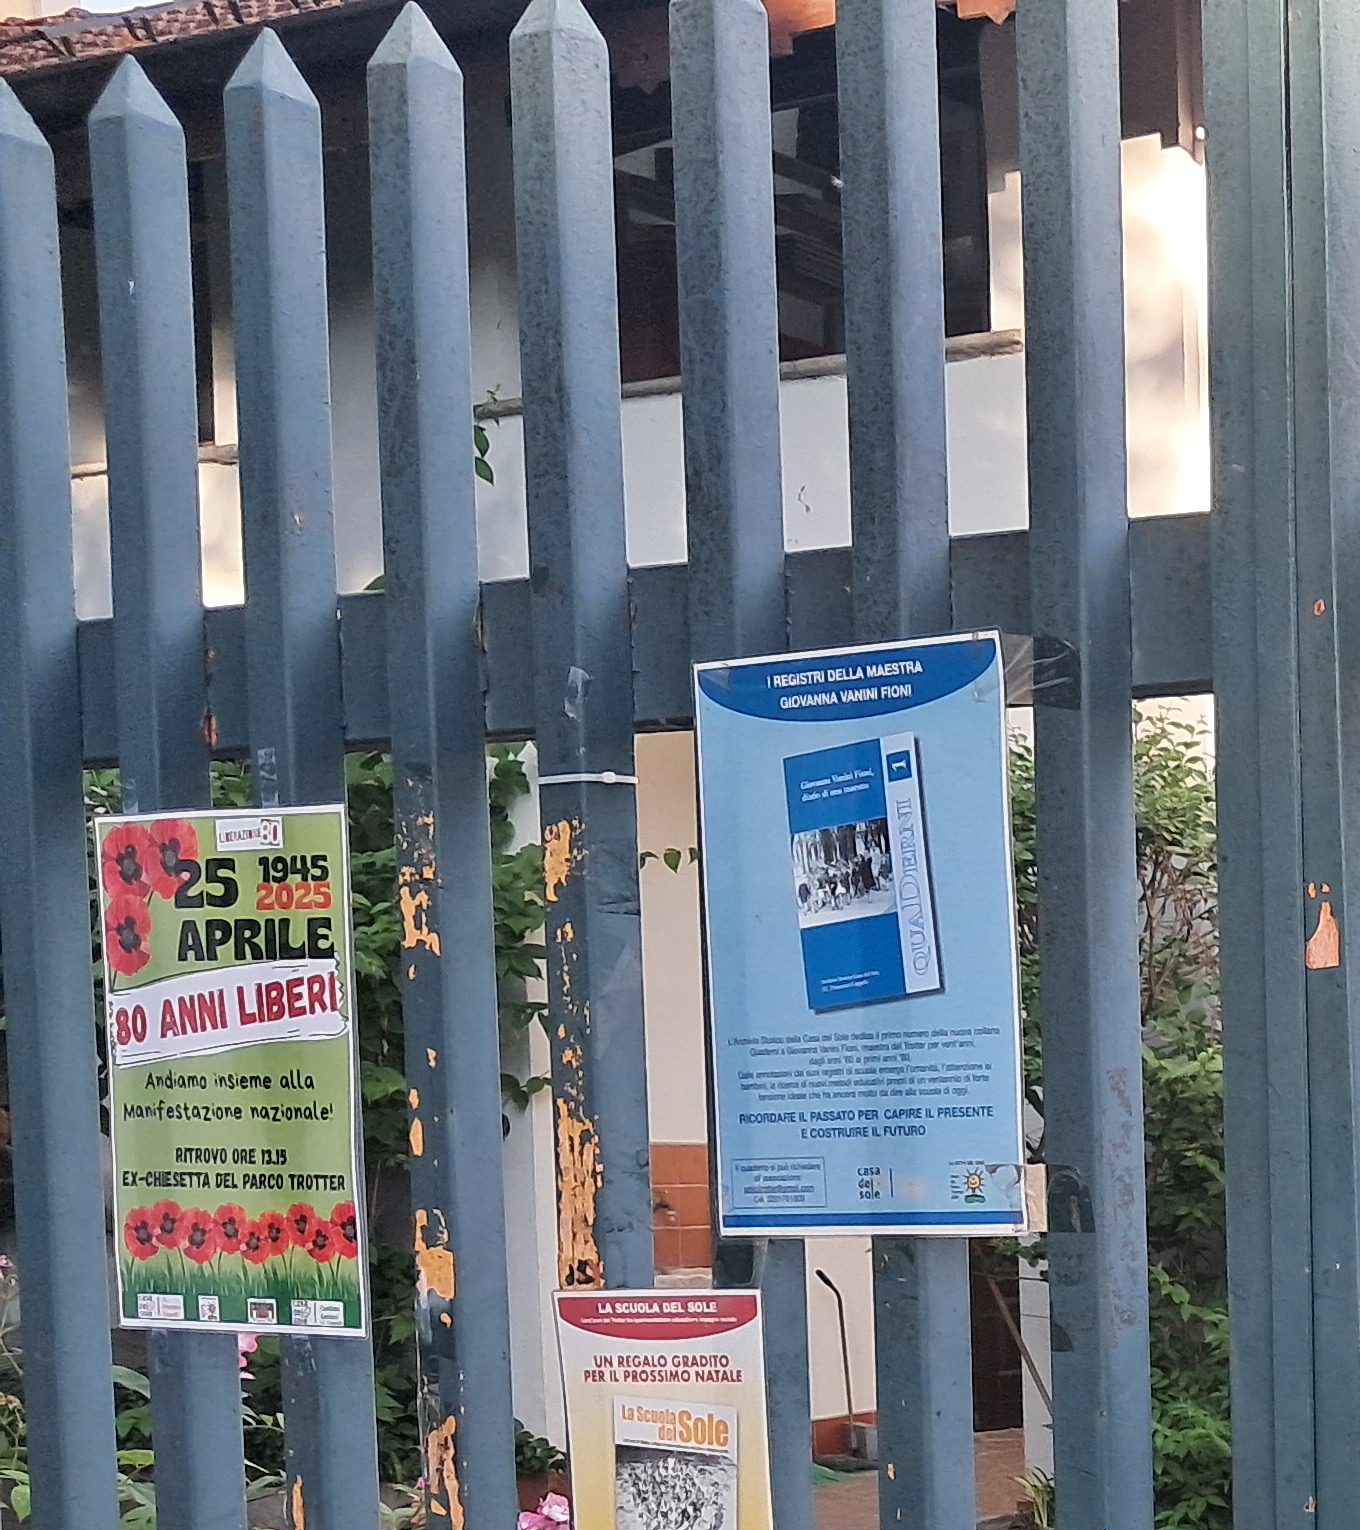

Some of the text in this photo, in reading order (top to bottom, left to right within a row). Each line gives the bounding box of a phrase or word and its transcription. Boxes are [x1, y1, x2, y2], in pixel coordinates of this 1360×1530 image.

[774, 670, 825, 688] REGISTRI
[827, 666, 864, 682] DELLA
[866, 660, 924, 677] MAESTRA
[780, 683, 912, 709] GIOVANNA VANINI FIONI
[174, 854, 330, 908] 25 1945
[896, 798, 932, 976] QUADERNI
[256, 882, 332, 910] 2025
[178, 917, 335, 961] APRILE
[116, 971, 338, 1045] 80 ANNI LIBERI
[145, 1069, 315, 1090] Andiamo insieme alla
[123, 1100, 333, 1122] Manifestazione nazionale!
[739, 1105, 994, 1124] RICORDARE IL PASSATO PER CAPIRE IL PRESENTE
[801, 1124, 926, 1139] E COSTRUIRE IL FUTURO
[175, 1147, 227, 1165] RITROVO
[232, 1148, 257, 1165] ORE
[122, 1170, 346, 1191] EX-CHIESETTA DEL PARCO TROTTER
[857, 1166, 881, 1176] casa
[859, 1189, 881, 1200] sole
[597, 1301, 718, 1314] LA SCUOLA DEL SOLE
[594, 1355, 730, 1369] UN REGALO GRADITO
[584, 1370, 743, 1383] PER IL PROSSIMO NATALE
[621, 1403, 676, 1425] La Scuola
[658, 1425, 677, 1441] del
[678, 1409, 729, 1448] Sole
